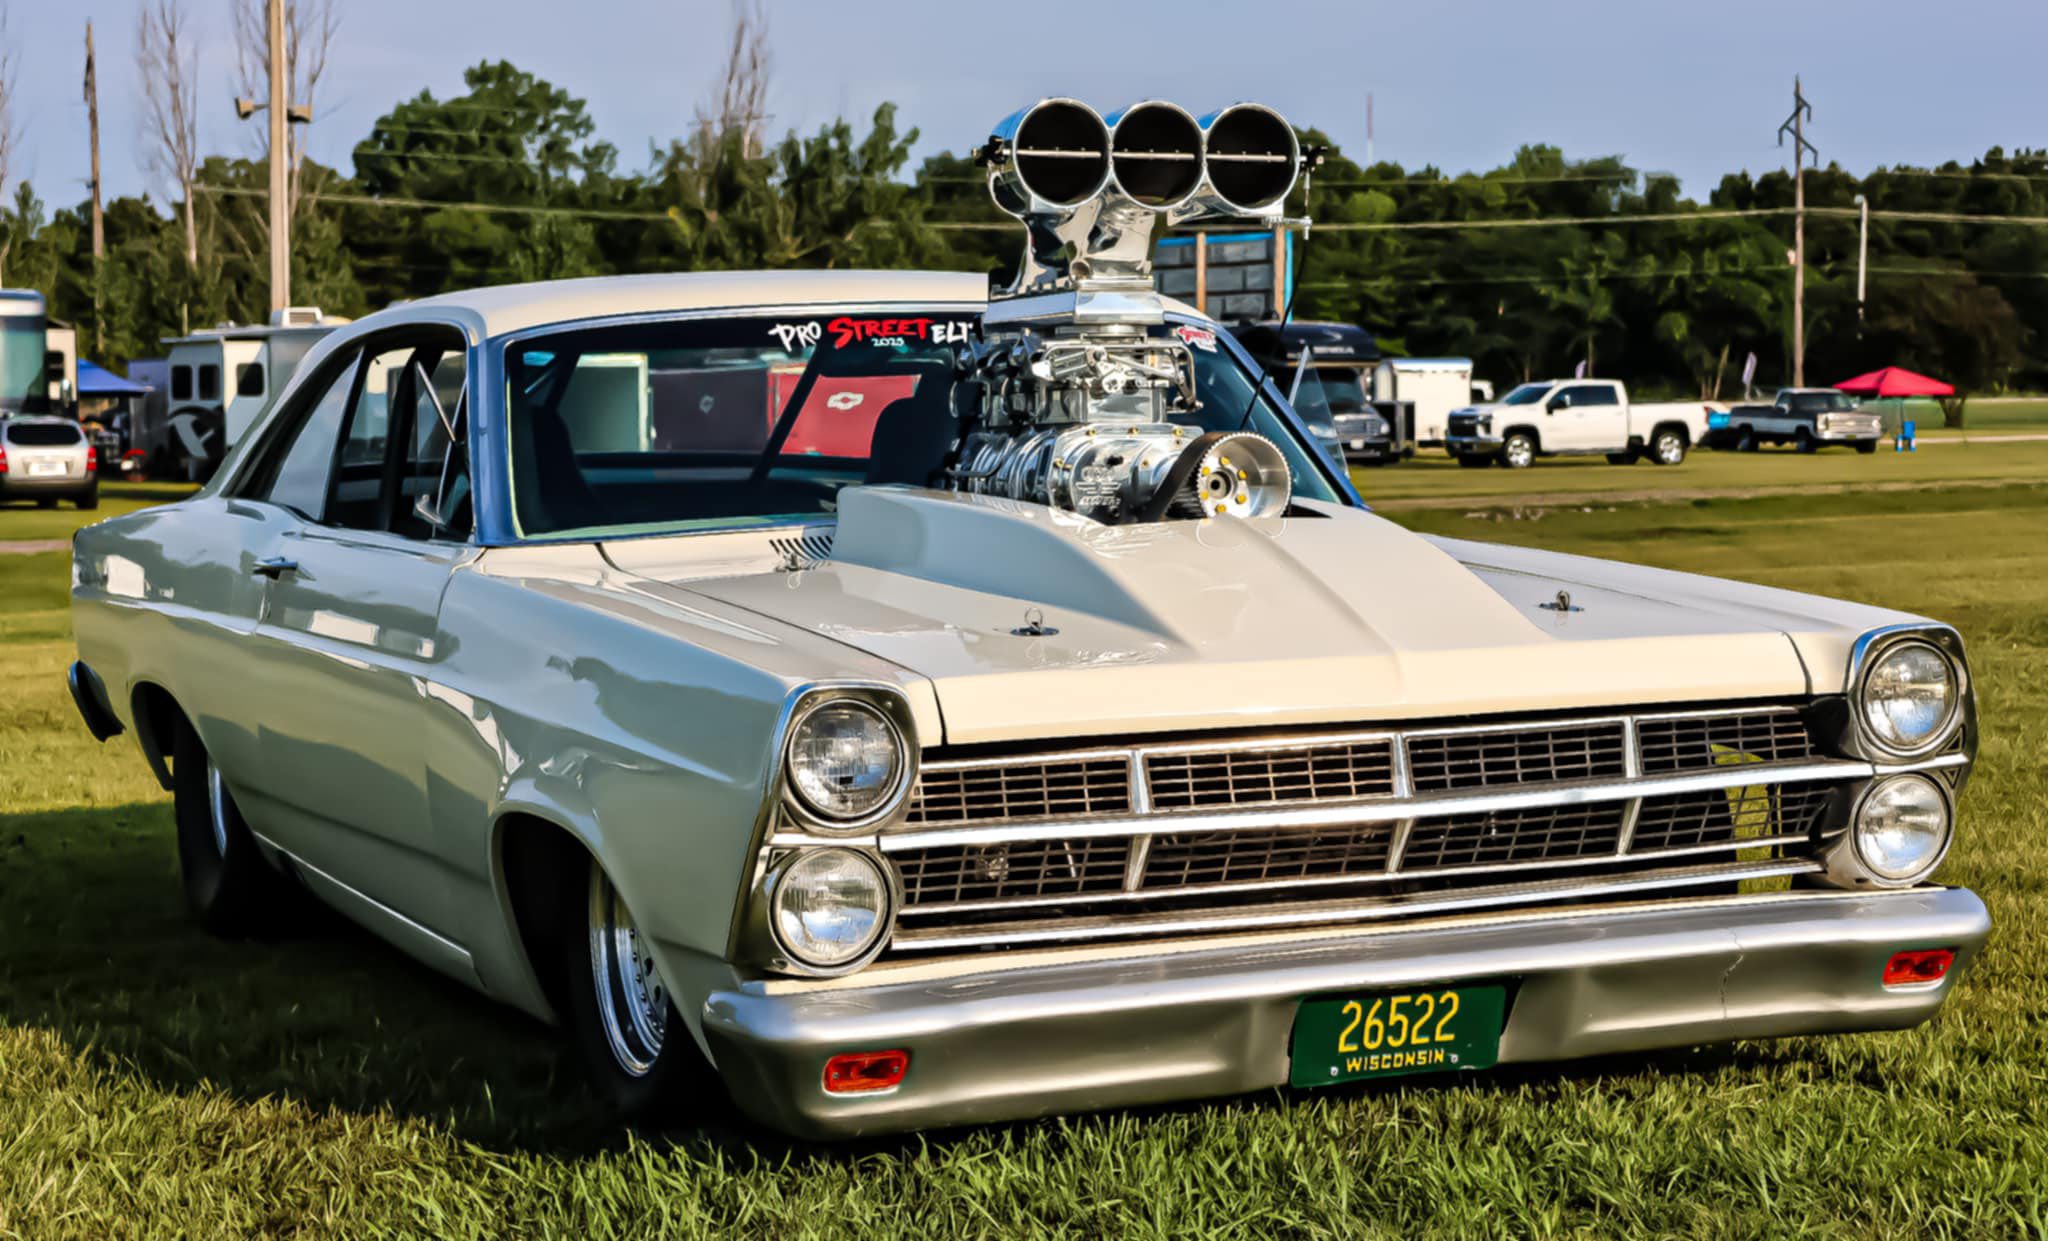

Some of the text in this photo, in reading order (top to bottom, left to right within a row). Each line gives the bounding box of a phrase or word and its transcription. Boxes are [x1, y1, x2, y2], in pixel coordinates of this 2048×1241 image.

[768, 321, 822, 352] PRO
[827, 316, 934, 349] STREET
[1338, 991, 1460, 1053] 26522
[1346, 1049, 1445, 1072] WISCONSIN
